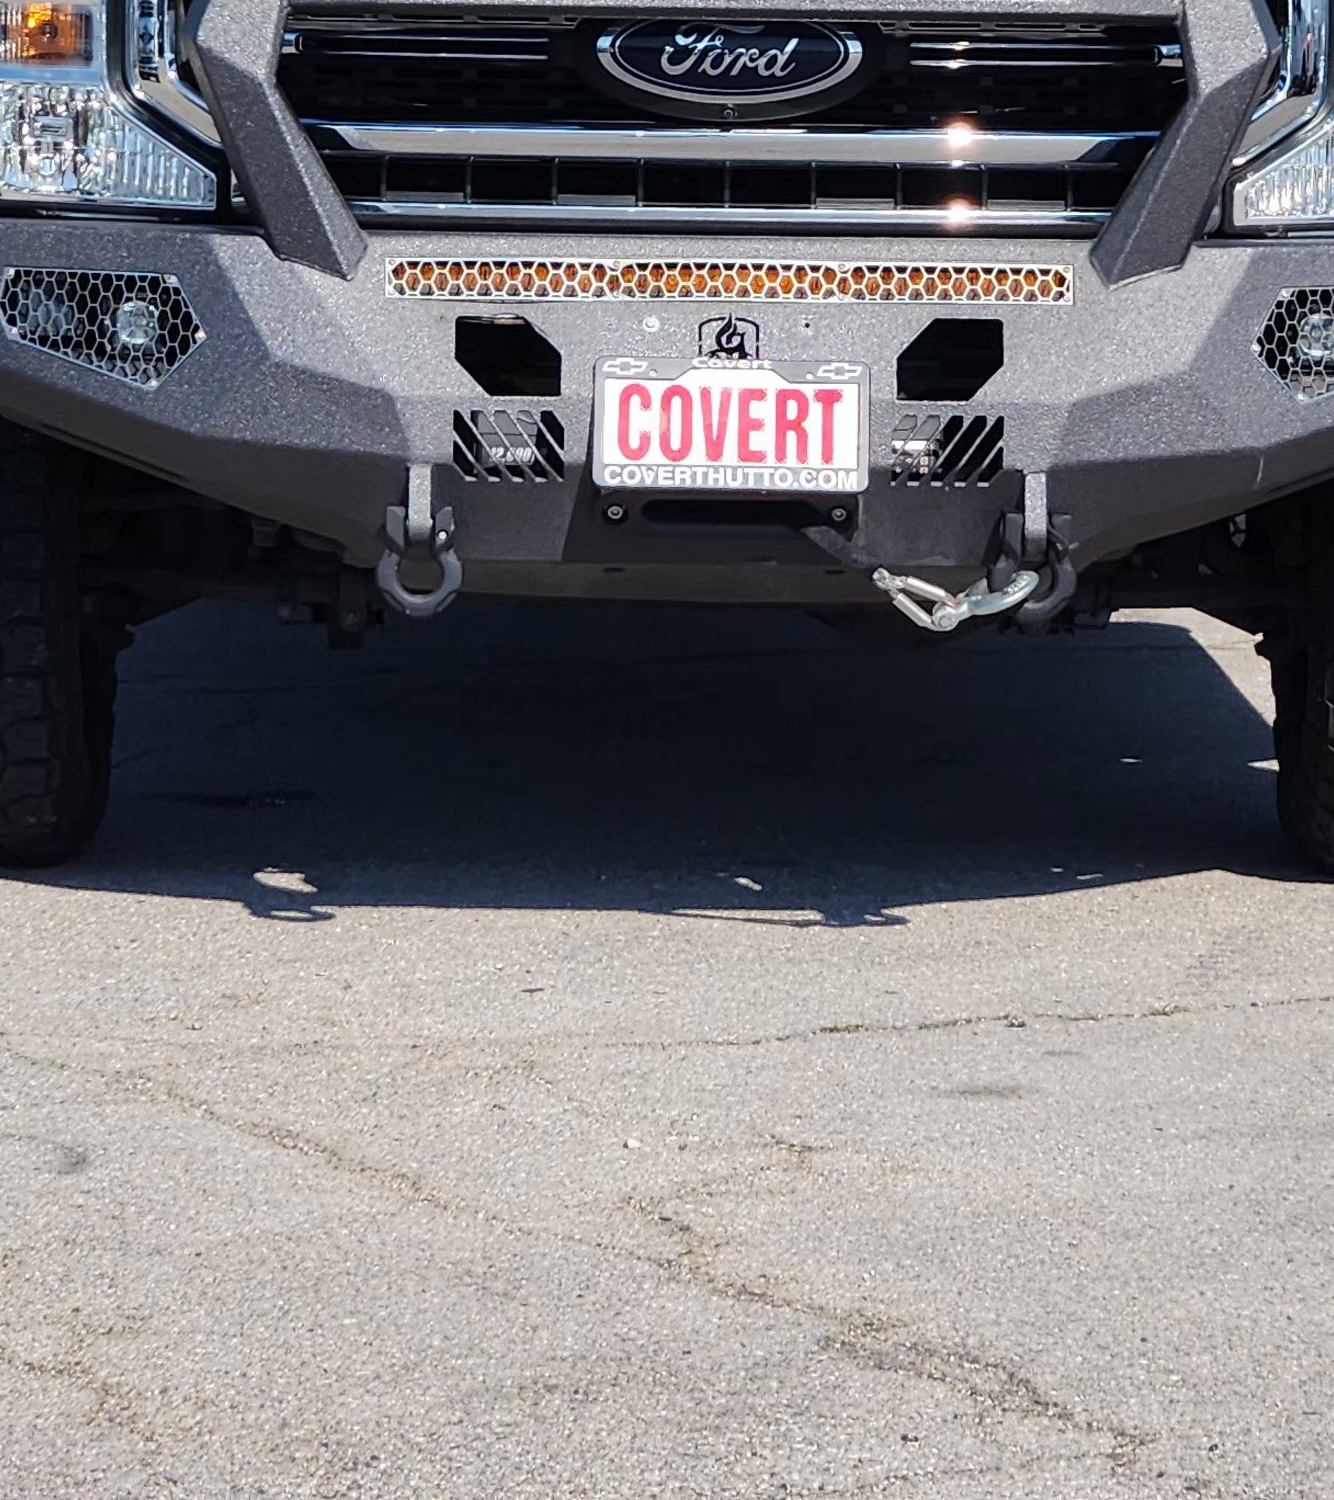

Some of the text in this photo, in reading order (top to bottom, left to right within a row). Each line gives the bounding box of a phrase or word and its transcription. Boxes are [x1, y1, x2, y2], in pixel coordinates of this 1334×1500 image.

[660, 22, 800, 77] Ford
[691, 357, 772, 369] Covert
[617, 383, 844, 465] COVERT
[603, 465, 858, 490] COVERTHUTTO.COM
